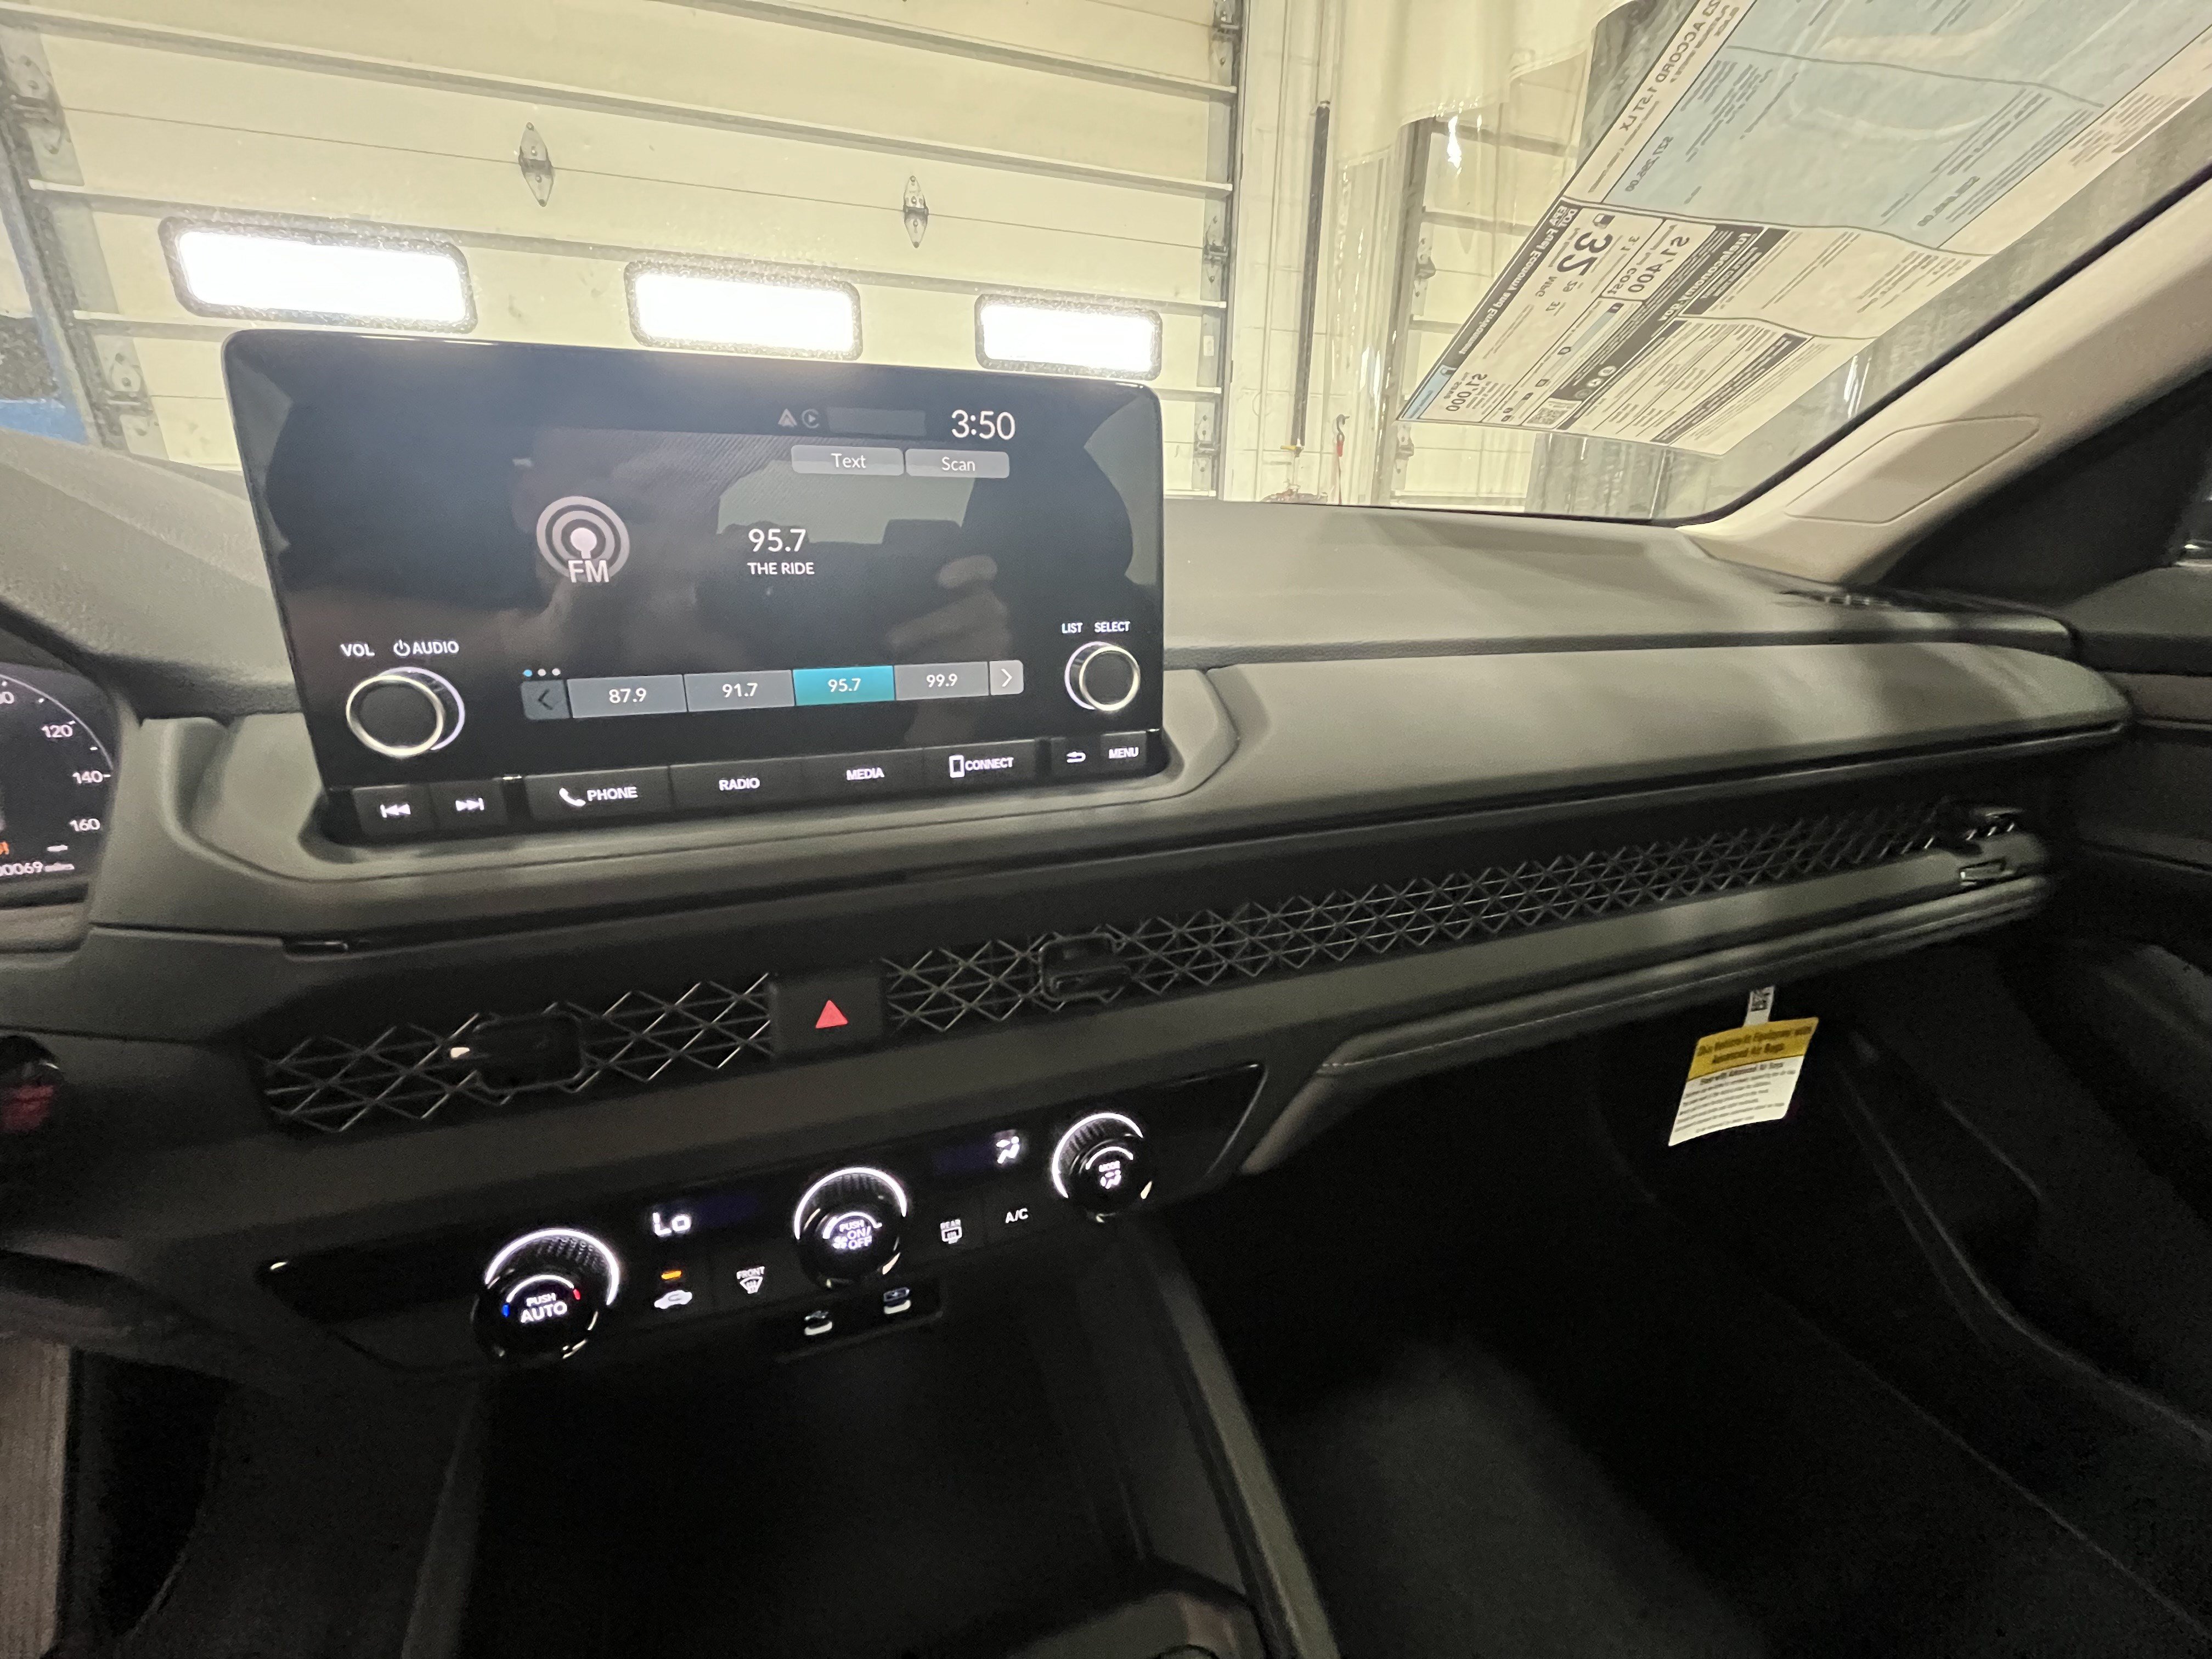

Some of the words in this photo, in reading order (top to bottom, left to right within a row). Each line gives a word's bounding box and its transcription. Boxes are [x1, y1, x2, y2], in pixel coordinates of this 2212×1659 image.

[950, 409, 1016, 439] 3:50
[831, 452, 867, 469] Text
[941, 455, 977, 472] Scan
[747, 528, 807, 552] 95.7
[568, 560, 610, 583] FM
[747, 562, 778, 575] THE
[782, 561, 815, 575] RIDE
[1062, 622, 1083, 634] LIST
[1094, 621, 1131, 633] SELECT
[340, 643, 375, 657] VOL
[413, 641, 460, 655] AUDIO
[828, 678, 861, 692] 95.7
[926, 673, 958, 688] 99.9
[608, 688, 647, 704] 87.9
[722, 682, 758, 698] 91.7
[41, 725, 73, 738] 120
[1108, 747, 1140, 759] MENU
[965, 757, 1014, 771] CONNECT
[72, 770, 103, 783] 140
[846, 767, 885, 781] MEDIA
[719, 777, 761, 791] RADIO
[587, 786, 639, 802] PHONE
[69, 818, 101, 832] 160
[1005, 1208, 1029, 1223] A/C
[839, 1219, 865, 1232] PUSH
[940, 1218, 962, 1229] REAR
[847, 1226, 872, 1239] ON/
[848, 1235, 873, 1250] OFF
[736, 1266, 765, 1280] FRONT
[526, 1291, 557, 1307] PUSH
[520, 1301, 568, 1324] AUTO
